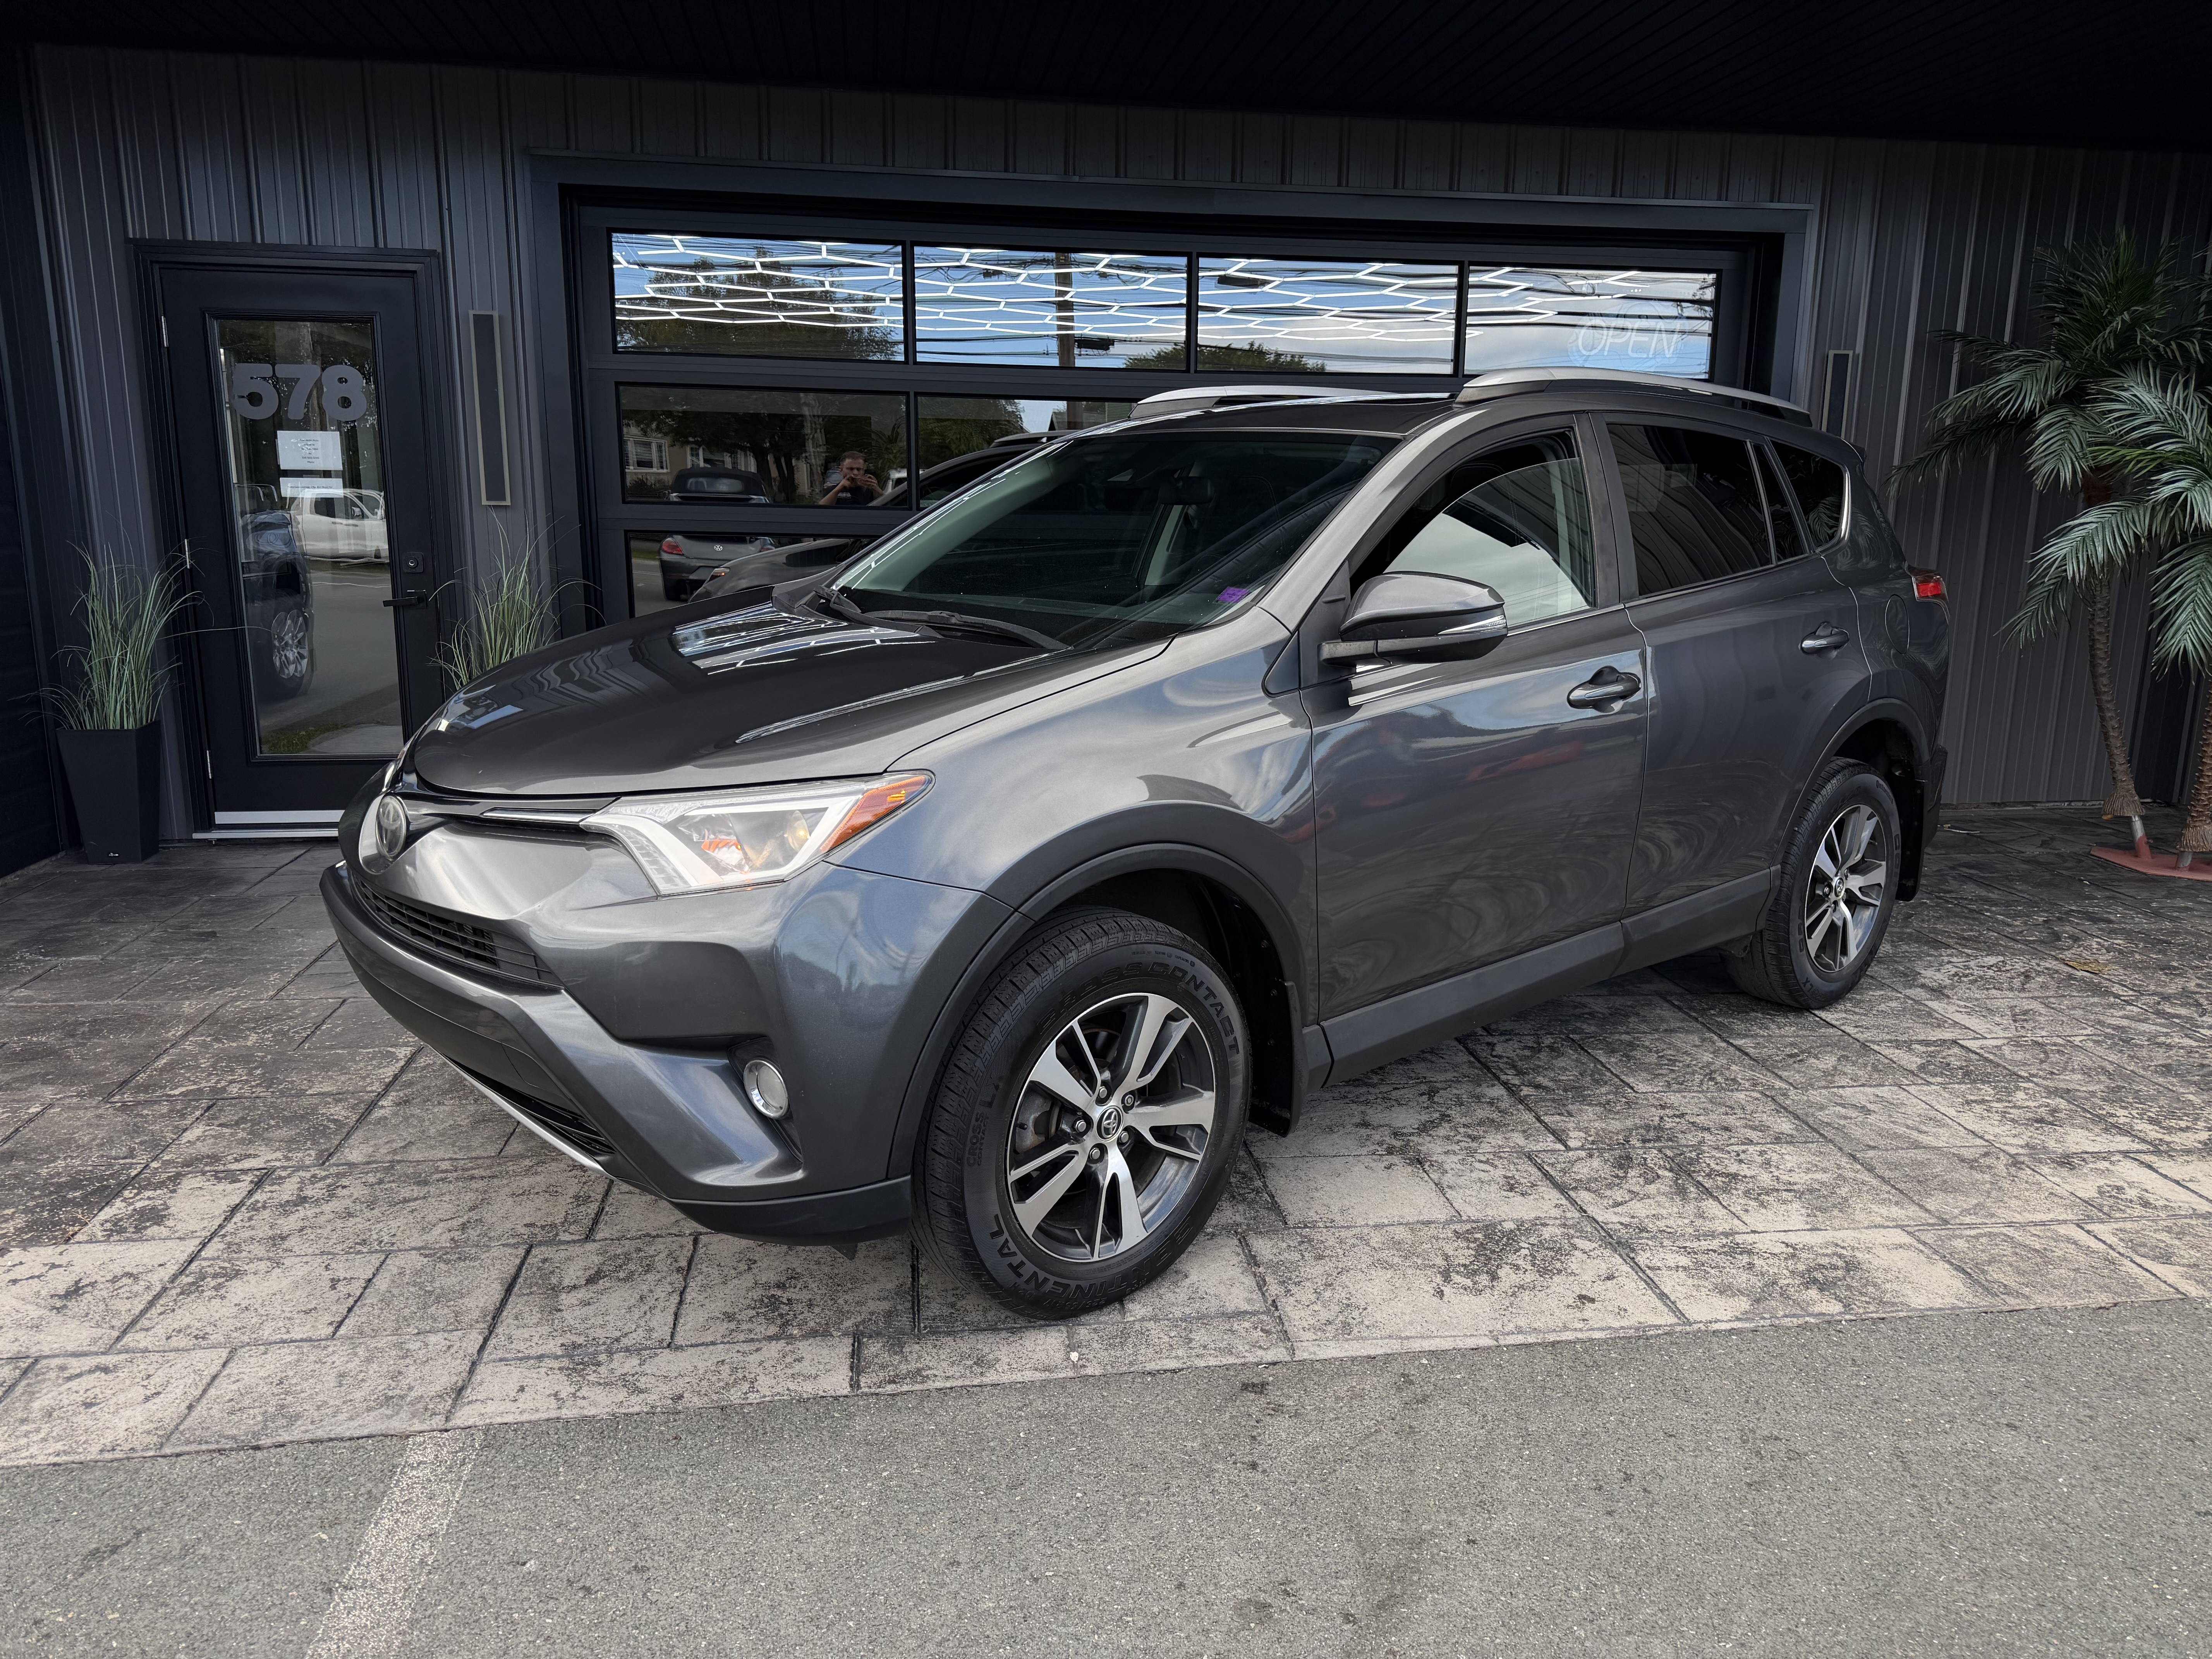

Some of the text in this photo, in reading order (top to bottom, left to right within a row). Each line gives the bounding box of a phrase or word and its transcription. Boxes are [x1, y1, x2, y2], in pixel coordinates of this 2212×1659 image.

[1578, 319, 1682, 358] OPEN
[232, 363, 367, 421] 578
[1037, 962, 1142, 1035] CROSS
[1147, 962, 1240, 1055] CONTACT
[967, 1111, 984, 1167] CROSS
[989, 1213, 1194, 1299] CONTINENTAL
